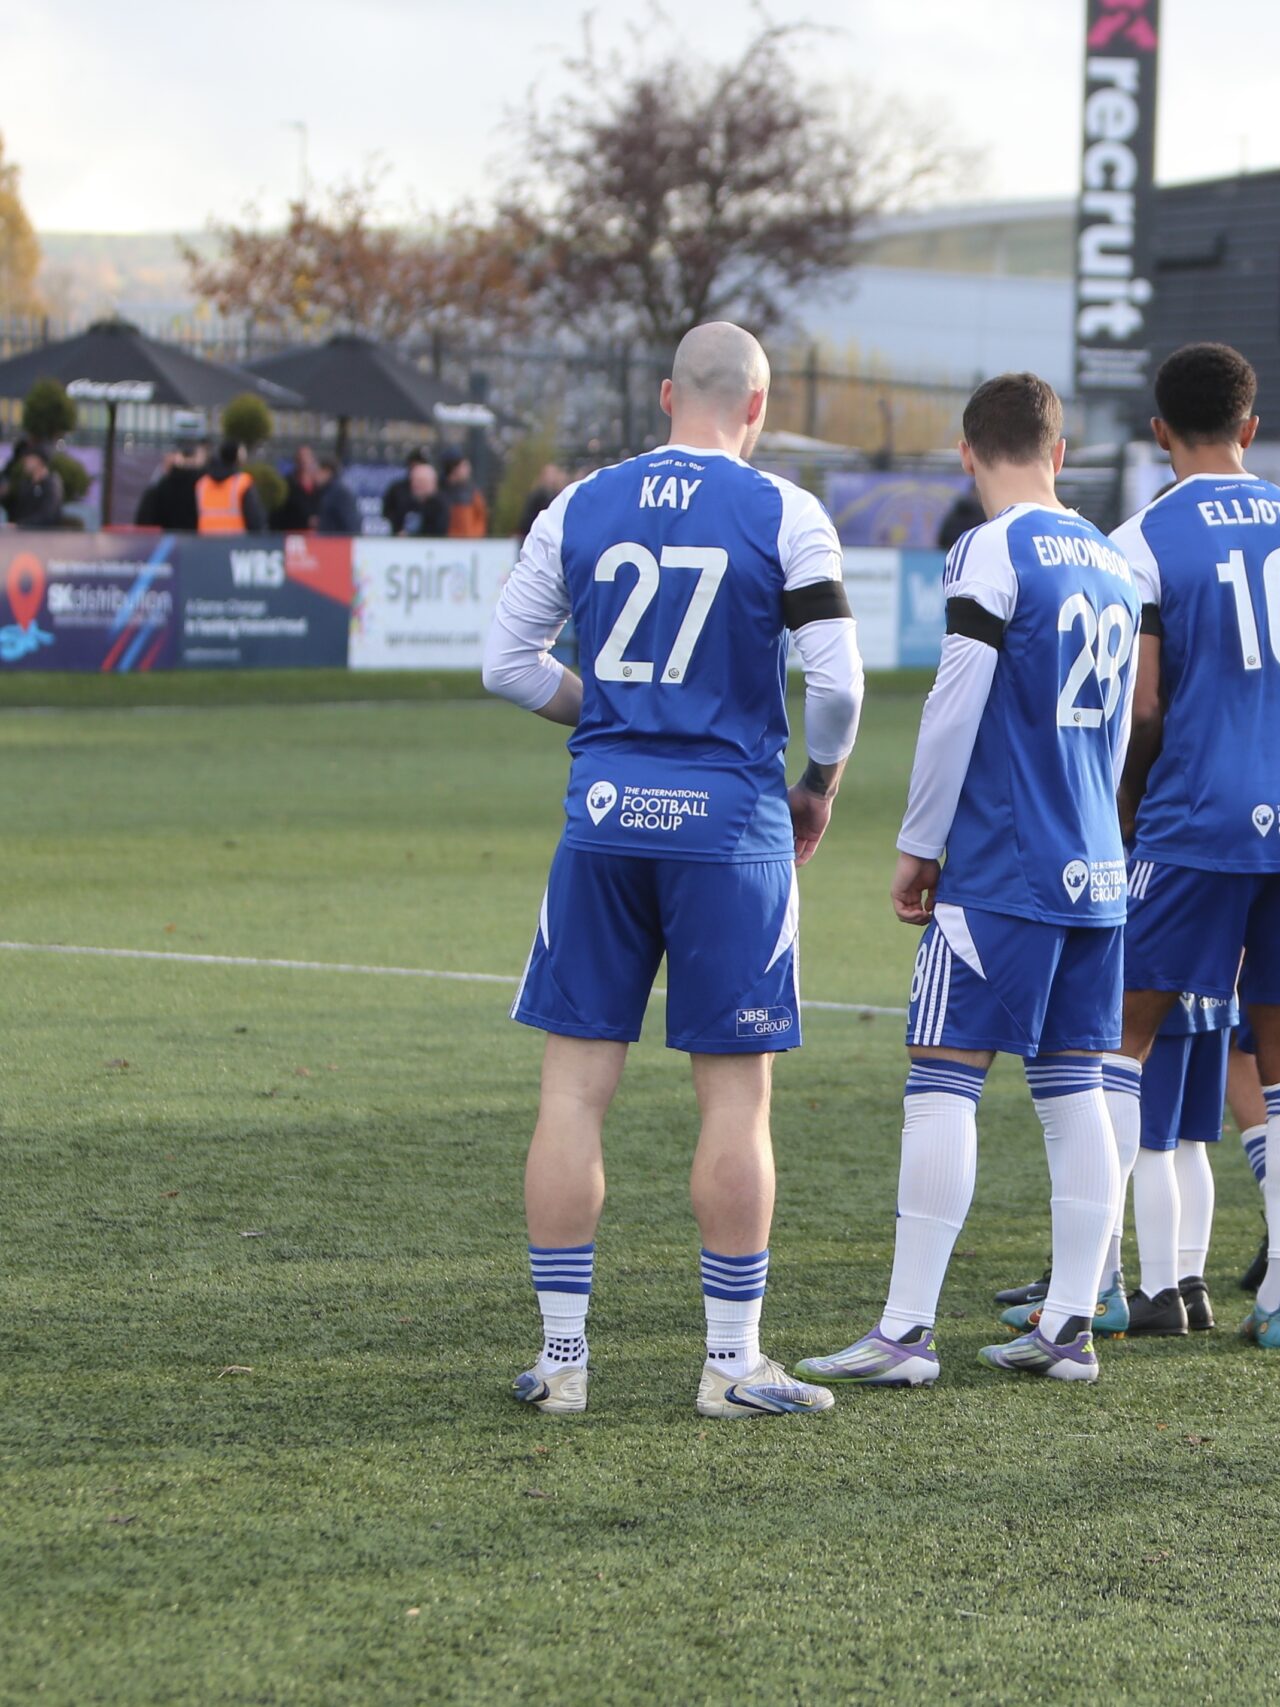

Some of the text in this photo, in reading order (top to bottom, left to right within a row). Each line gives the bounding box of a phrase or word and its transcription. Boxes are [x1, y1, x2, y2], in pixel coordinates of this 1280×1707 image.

[1077, 56, 1153, 341] recruit
[639, 475, 703, 511] KAY
[230, 549, 287, 589] WRS
[594, 541, 729, 684] 27
[1056, 592, 1134, 729] 28
[624, 786, 710, 800] THE INTERNATIONAL
[621, 795, 709, 817] FOOTBALL
[620, 811, 683, 831] GROUP
[1090, 870, 1127, 887] FOOTBA
[1090, 886, 1122, 903] GROUP
[738, 1009, 769, 1022] JBSi
[754, 1019, 790, 1034] GROUP
